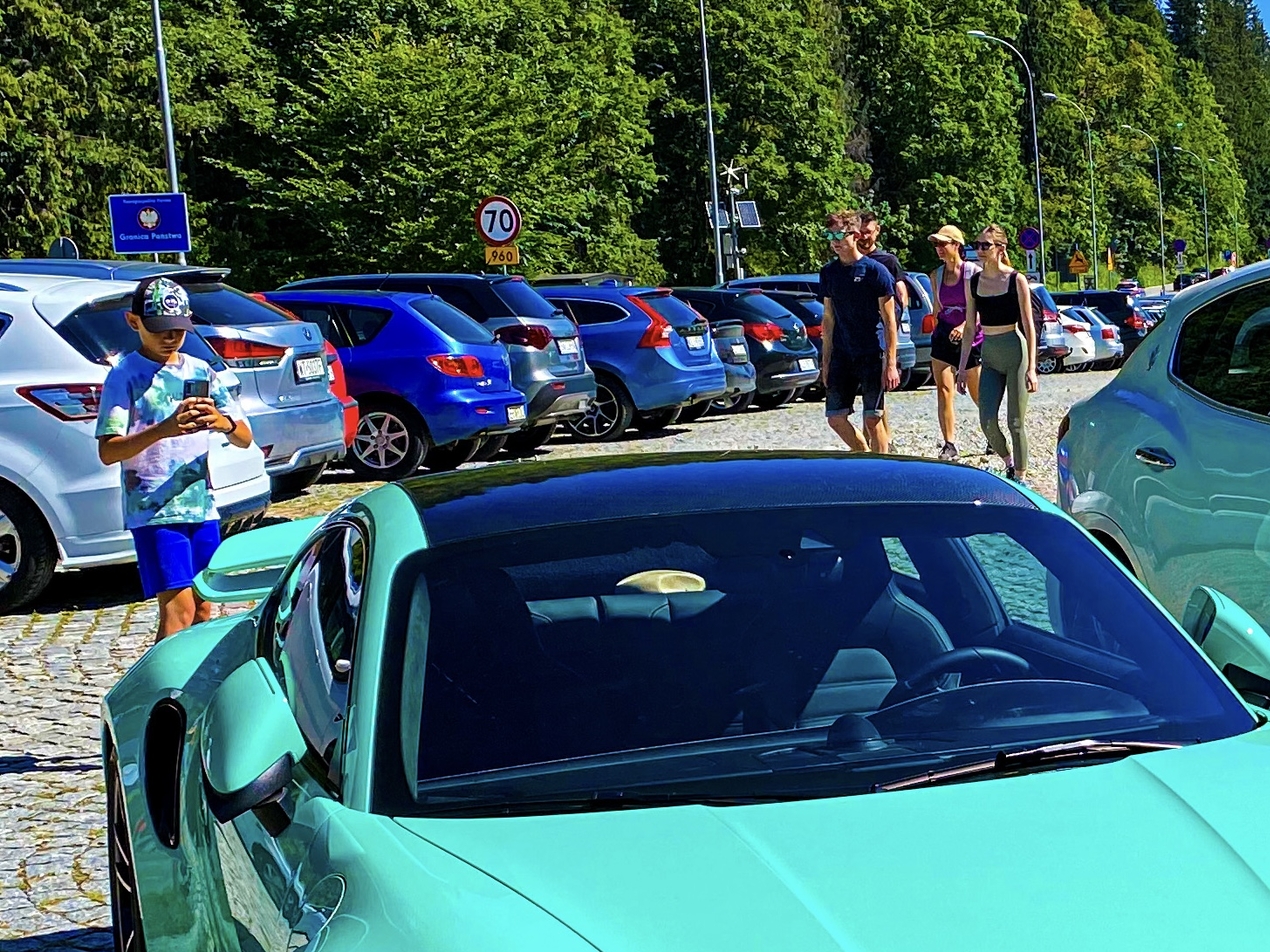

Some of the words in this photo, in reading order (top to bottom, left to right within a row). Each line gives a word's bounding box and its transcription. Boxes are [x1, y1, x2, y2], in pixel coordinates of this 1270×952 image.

[484, 208, 514, 233] 70
[119, 233, 149, 241] Granica
[492, 250, 513, 262] 960
